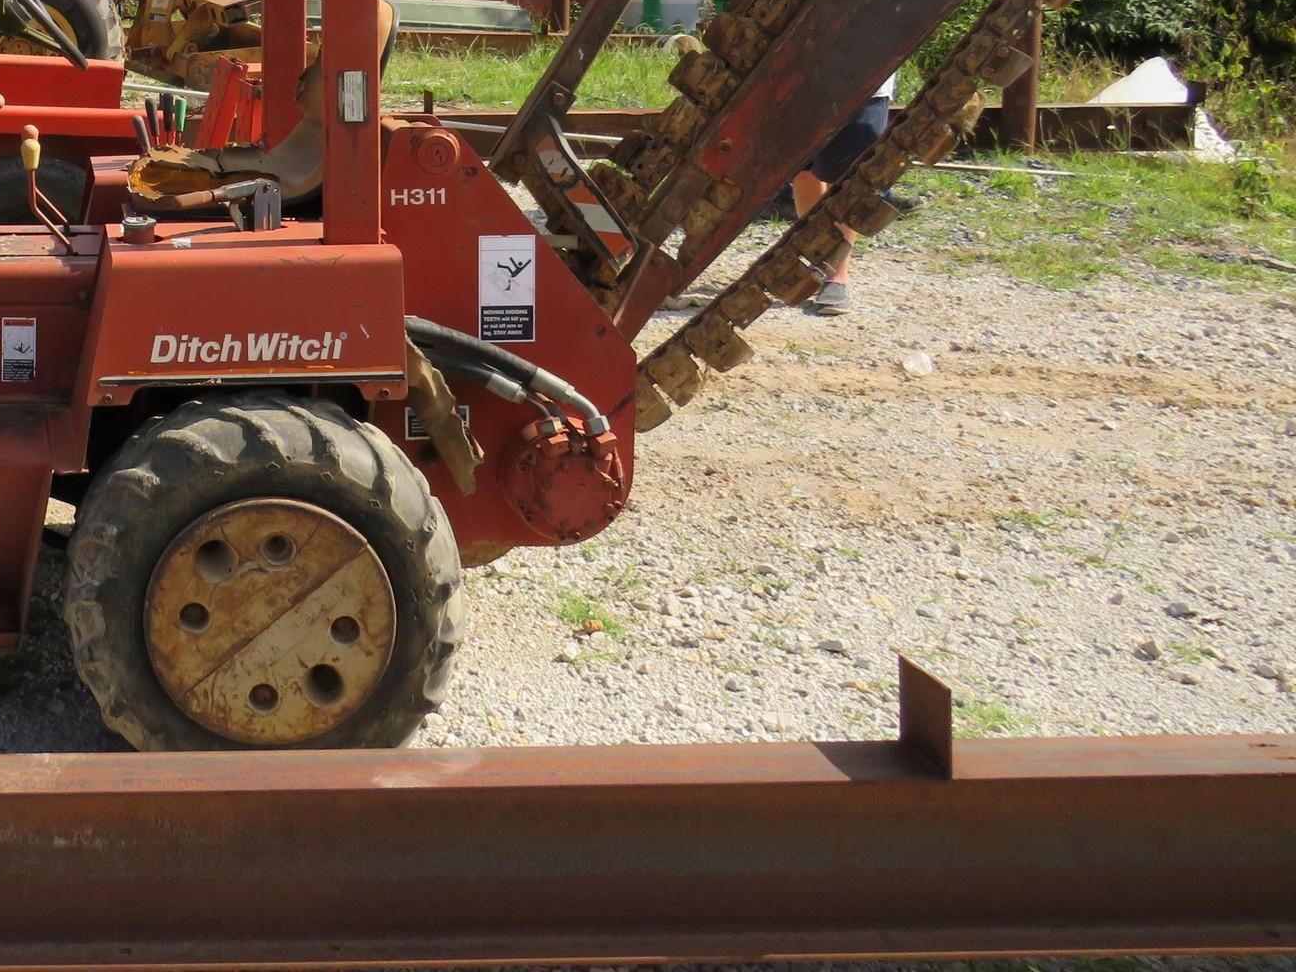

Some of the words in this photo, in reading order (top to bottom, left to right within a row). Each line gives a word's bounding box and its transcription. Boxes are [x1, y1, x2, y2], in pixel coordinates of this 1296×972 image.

[390, 187, 446, 206] H311
[150, 333, 242, 363] Ditch
[247, 331, 343, 361] Witch
